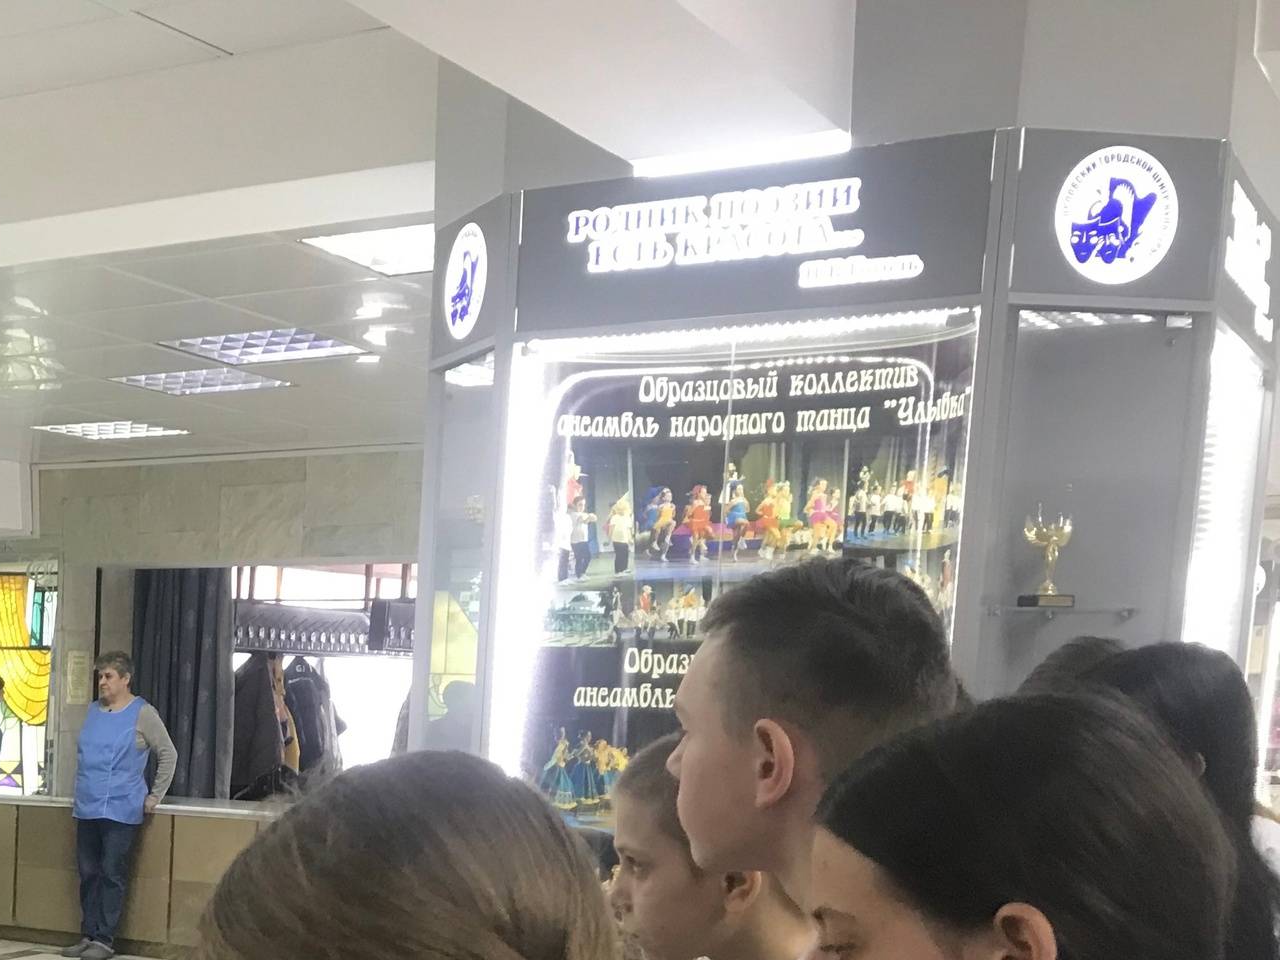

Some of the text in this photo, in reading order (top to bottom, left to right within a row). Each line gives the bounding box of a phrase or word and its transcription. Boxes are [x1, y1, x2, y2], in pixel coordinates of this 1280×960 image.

[639, 365, 919, 407] Образцовый коллектив
[669, 410, 785, 442] народного
[796, 407, 870, 433] танца
[624, 647, 696, 678] Образ
